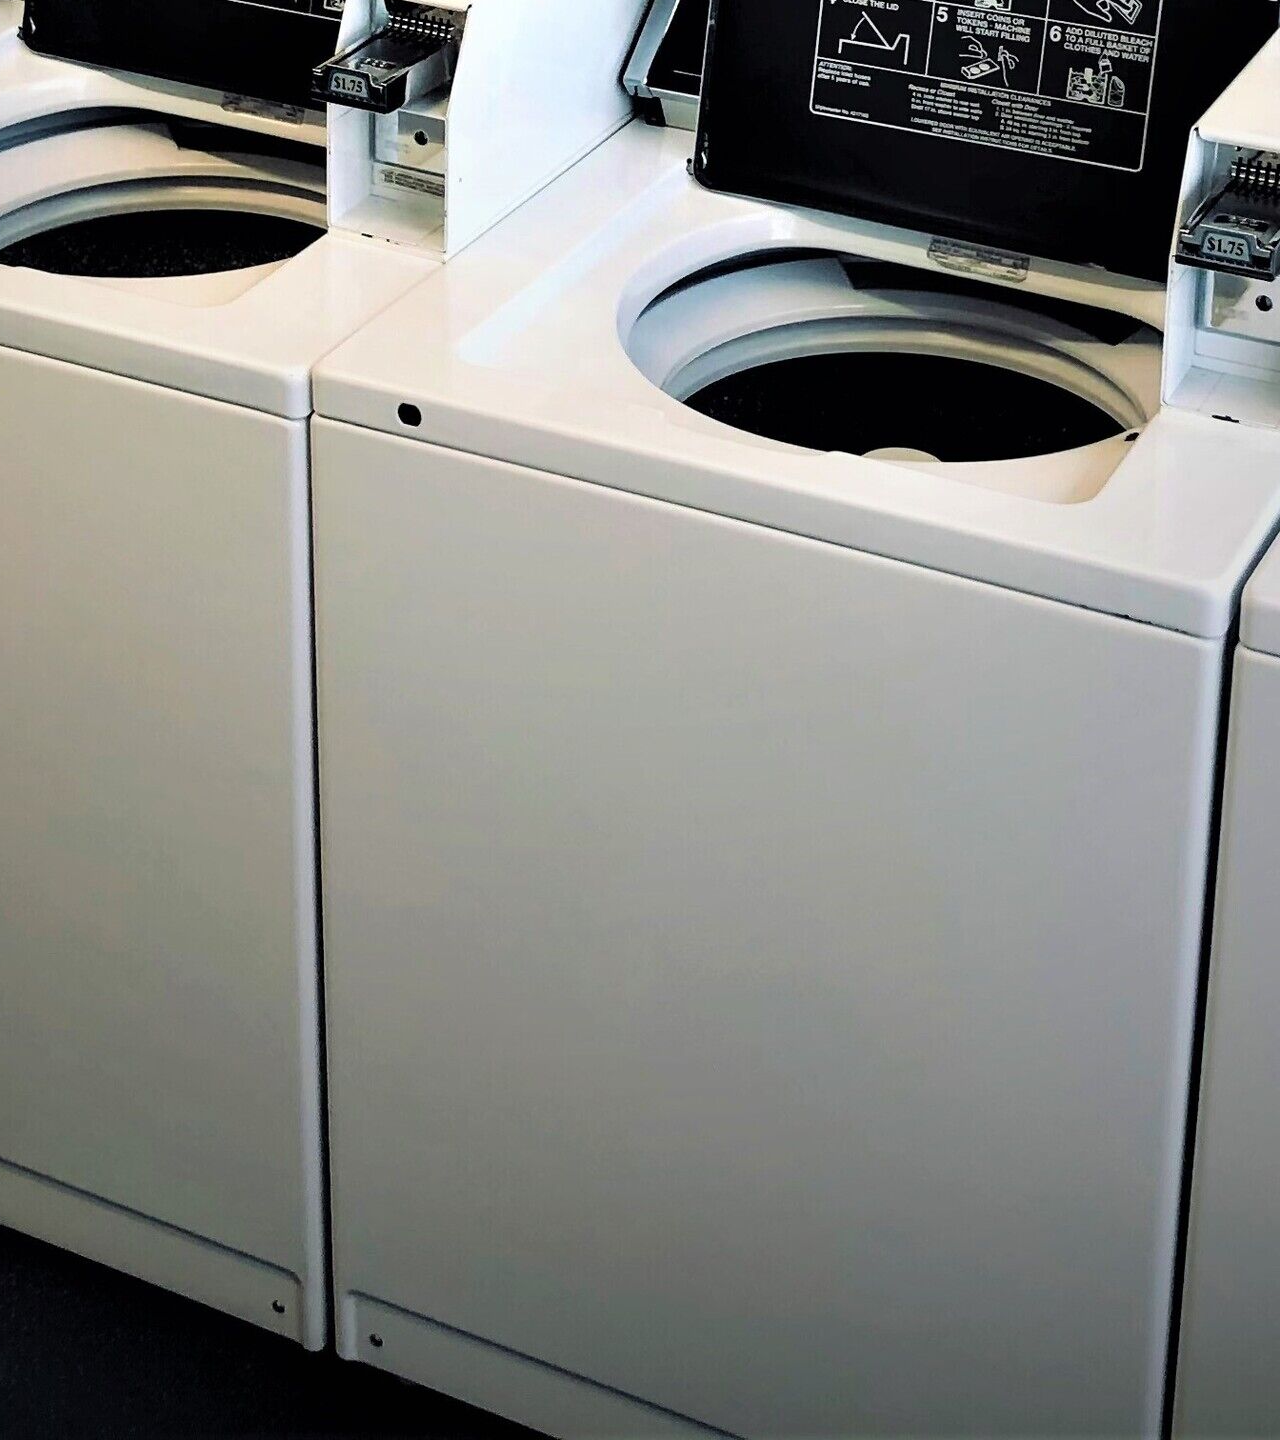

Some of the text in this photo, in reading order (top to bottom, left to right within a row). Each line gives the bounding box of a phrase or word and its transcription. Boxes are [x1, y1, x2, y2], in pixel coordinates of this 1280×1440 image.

[936, 6, 949, 23] 5
[1049, 25, 1062, 42] 6
[333, 75, 364, 93] $1.75
[1207, 235, 1245, 257] $1.75
